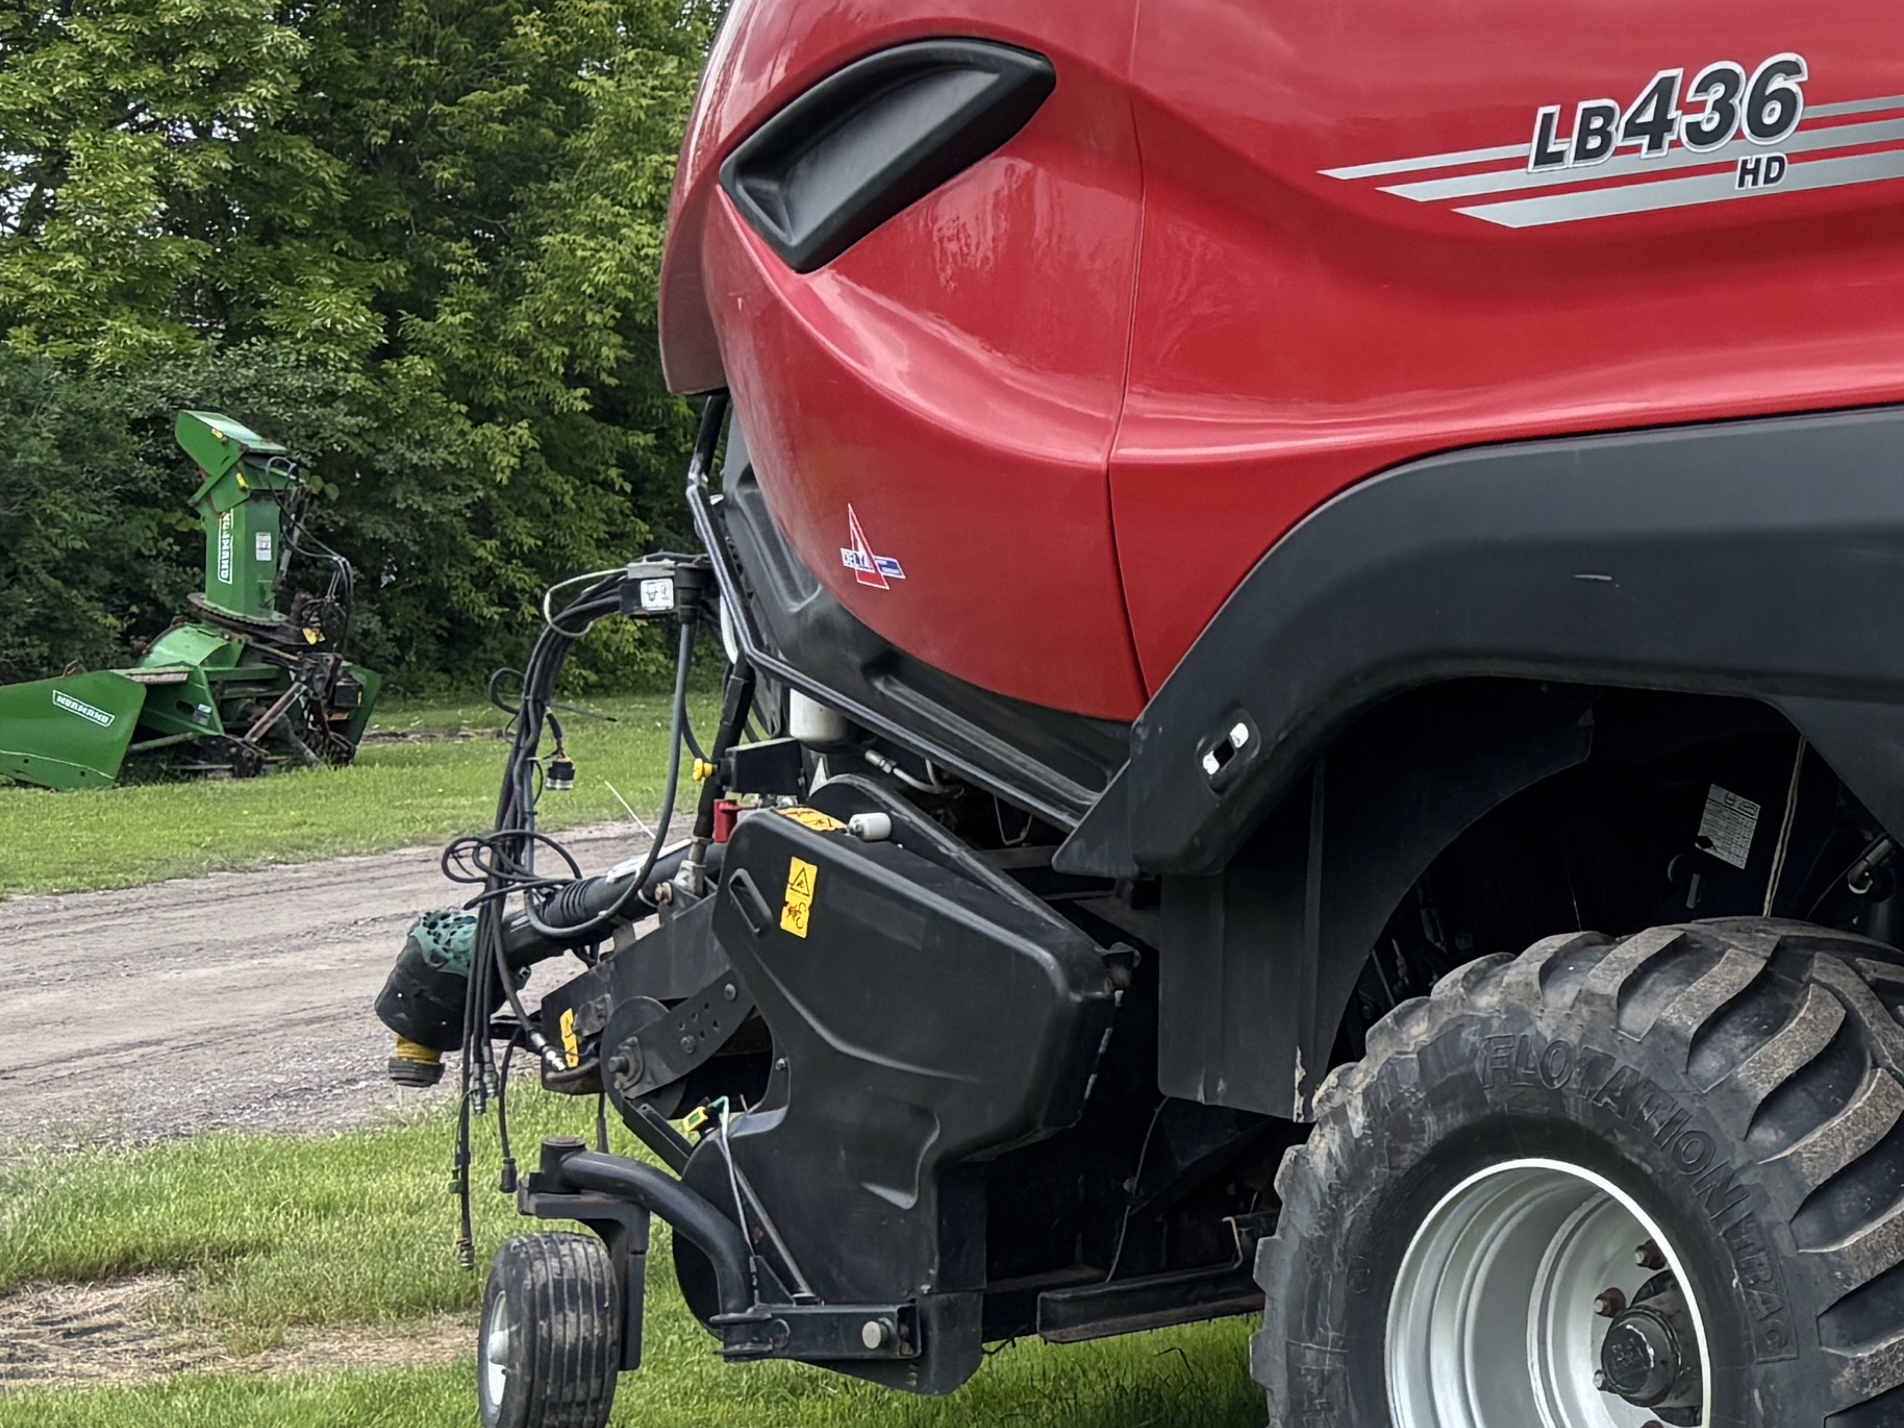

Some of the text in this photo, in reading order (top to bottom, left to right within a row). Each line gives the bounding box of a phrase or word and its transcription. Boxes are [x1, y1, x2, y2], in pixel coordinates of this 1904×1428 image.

[1527, 52, 1808, 173] LB436
[1736, 153, 1787, 191] HD
[1481, 1033, 1750, 1221] FLOTATION
